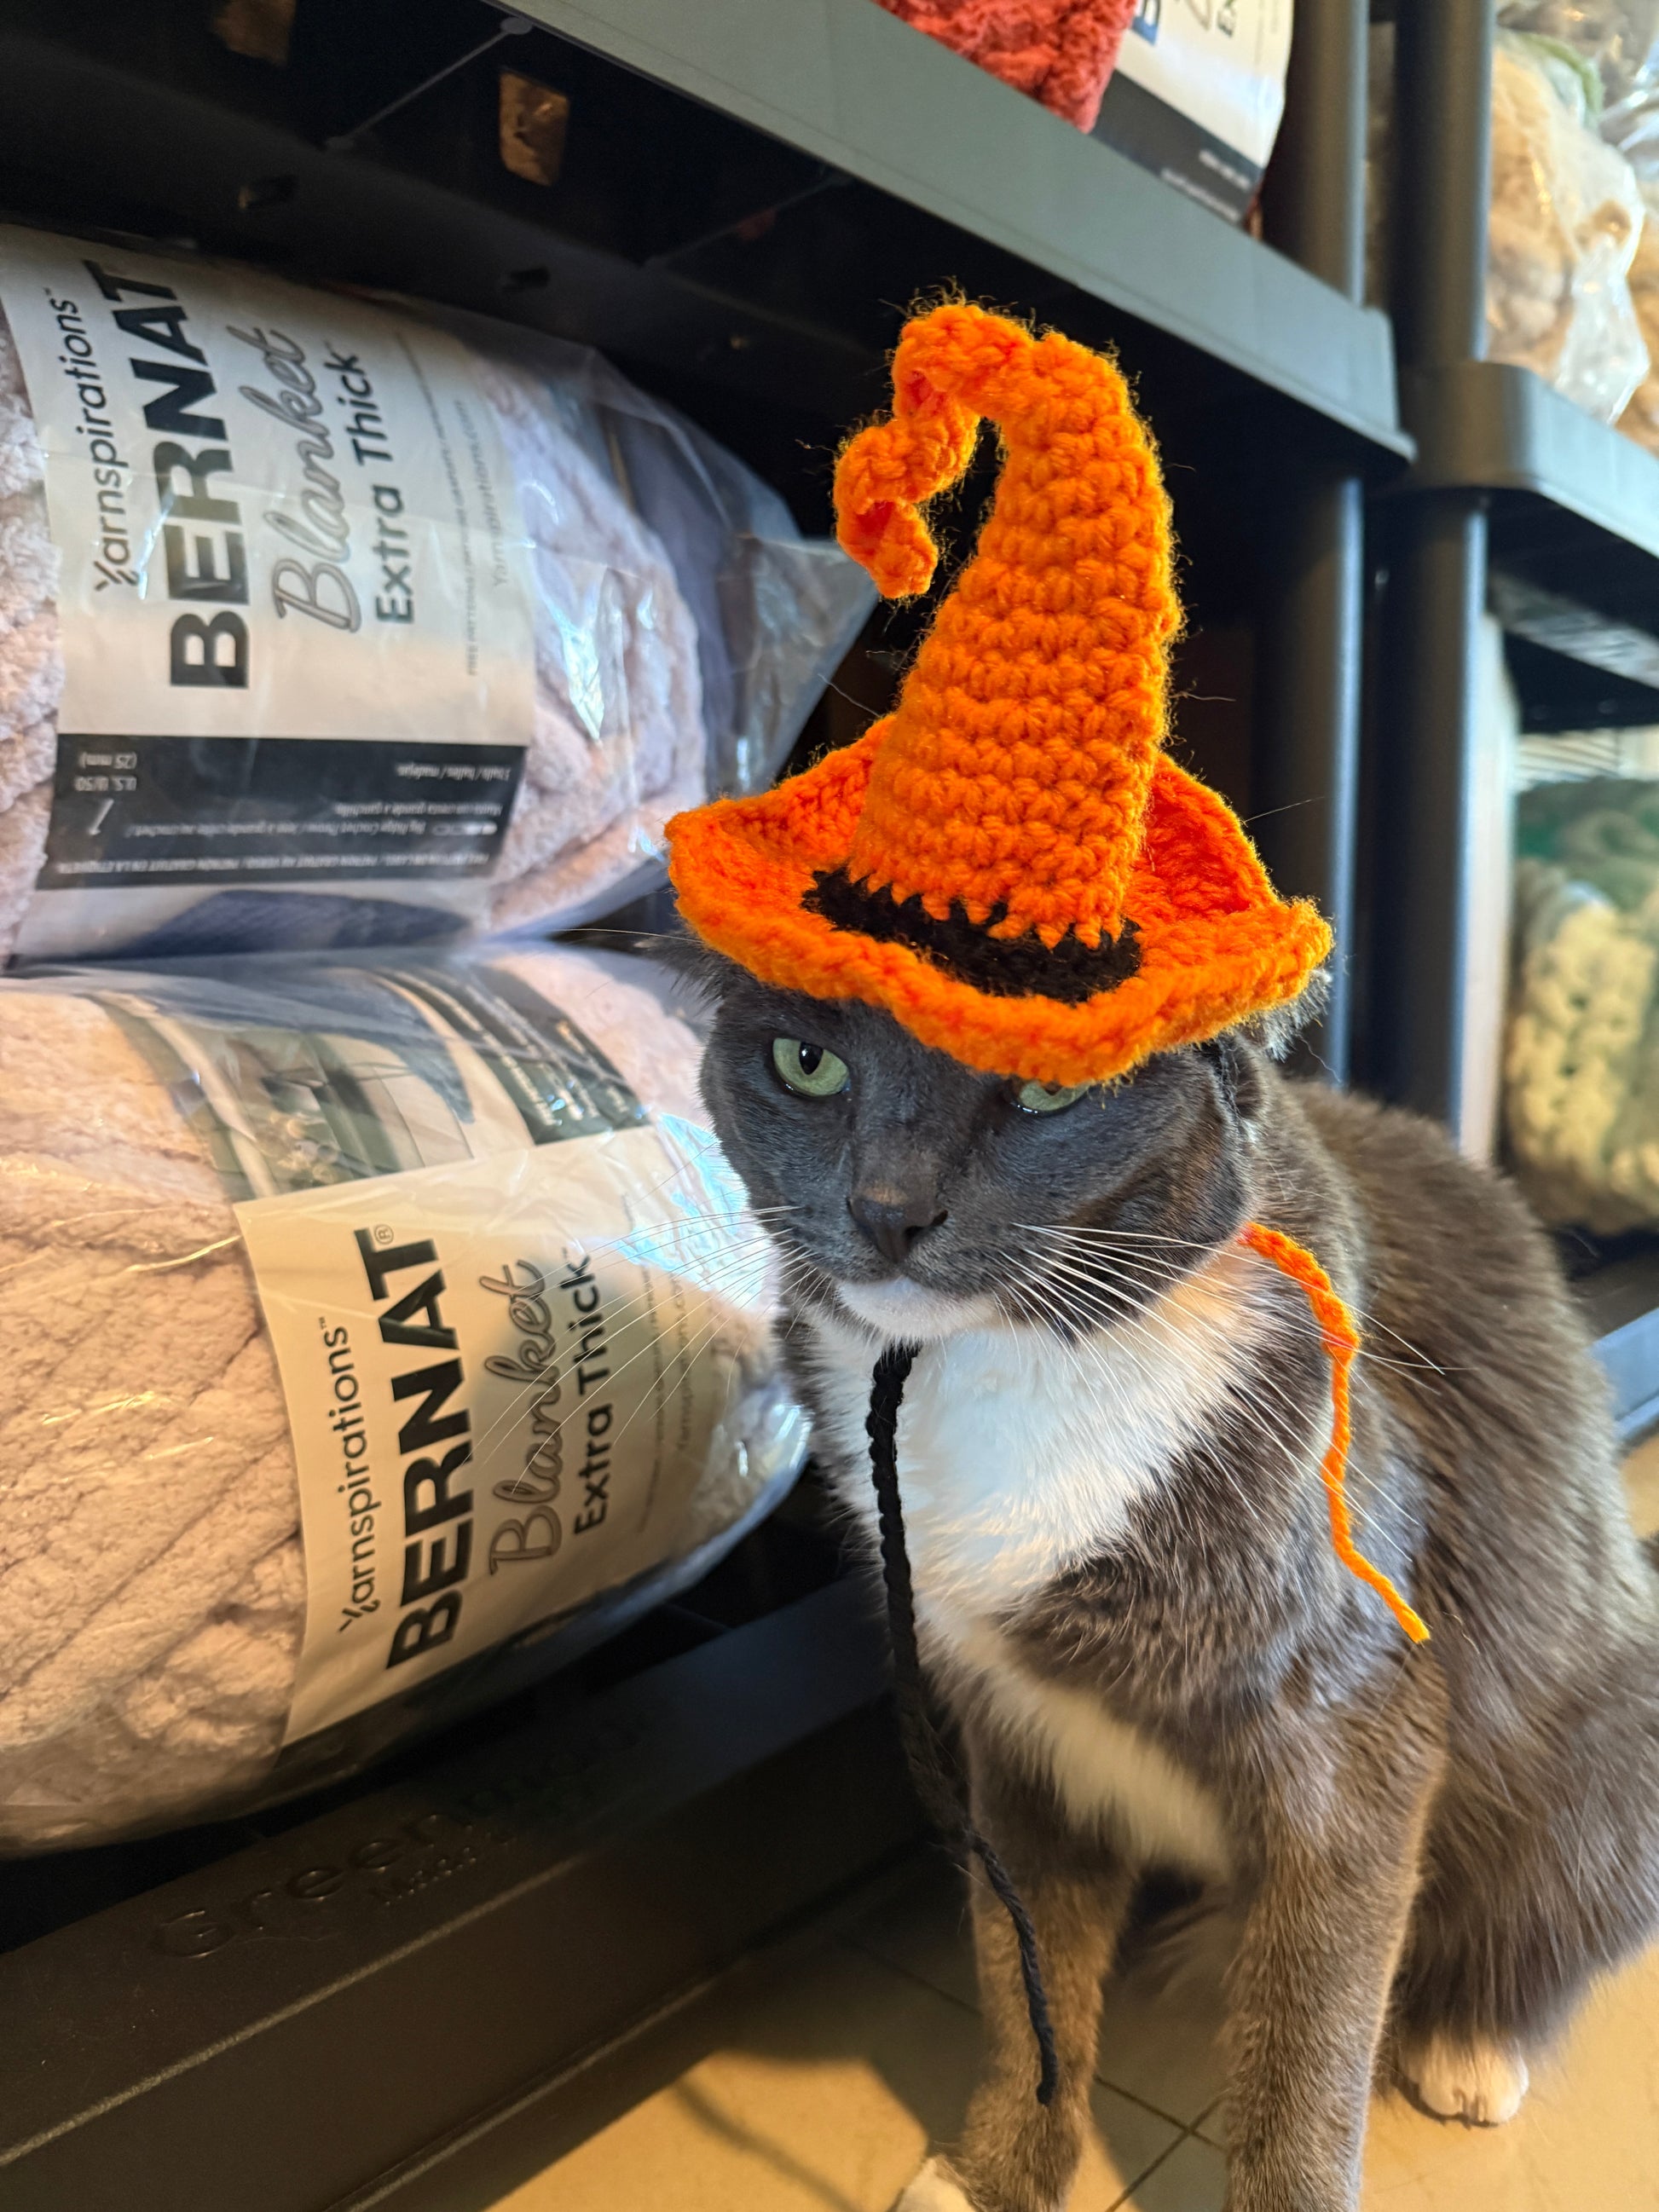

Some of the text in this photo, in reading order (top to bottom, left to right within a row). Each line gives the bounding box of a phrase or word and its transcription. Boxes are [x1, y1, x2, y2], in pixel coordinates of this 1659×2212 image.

[84, 258, 250, 689] BERNAT
[225, 324, 361, 633] Blanket
[324, 352, 414, 624] Extra Thick
[479, 1259, 564, 1576] Blanket
[559, 1254, 614, 1535] Extra Thick
